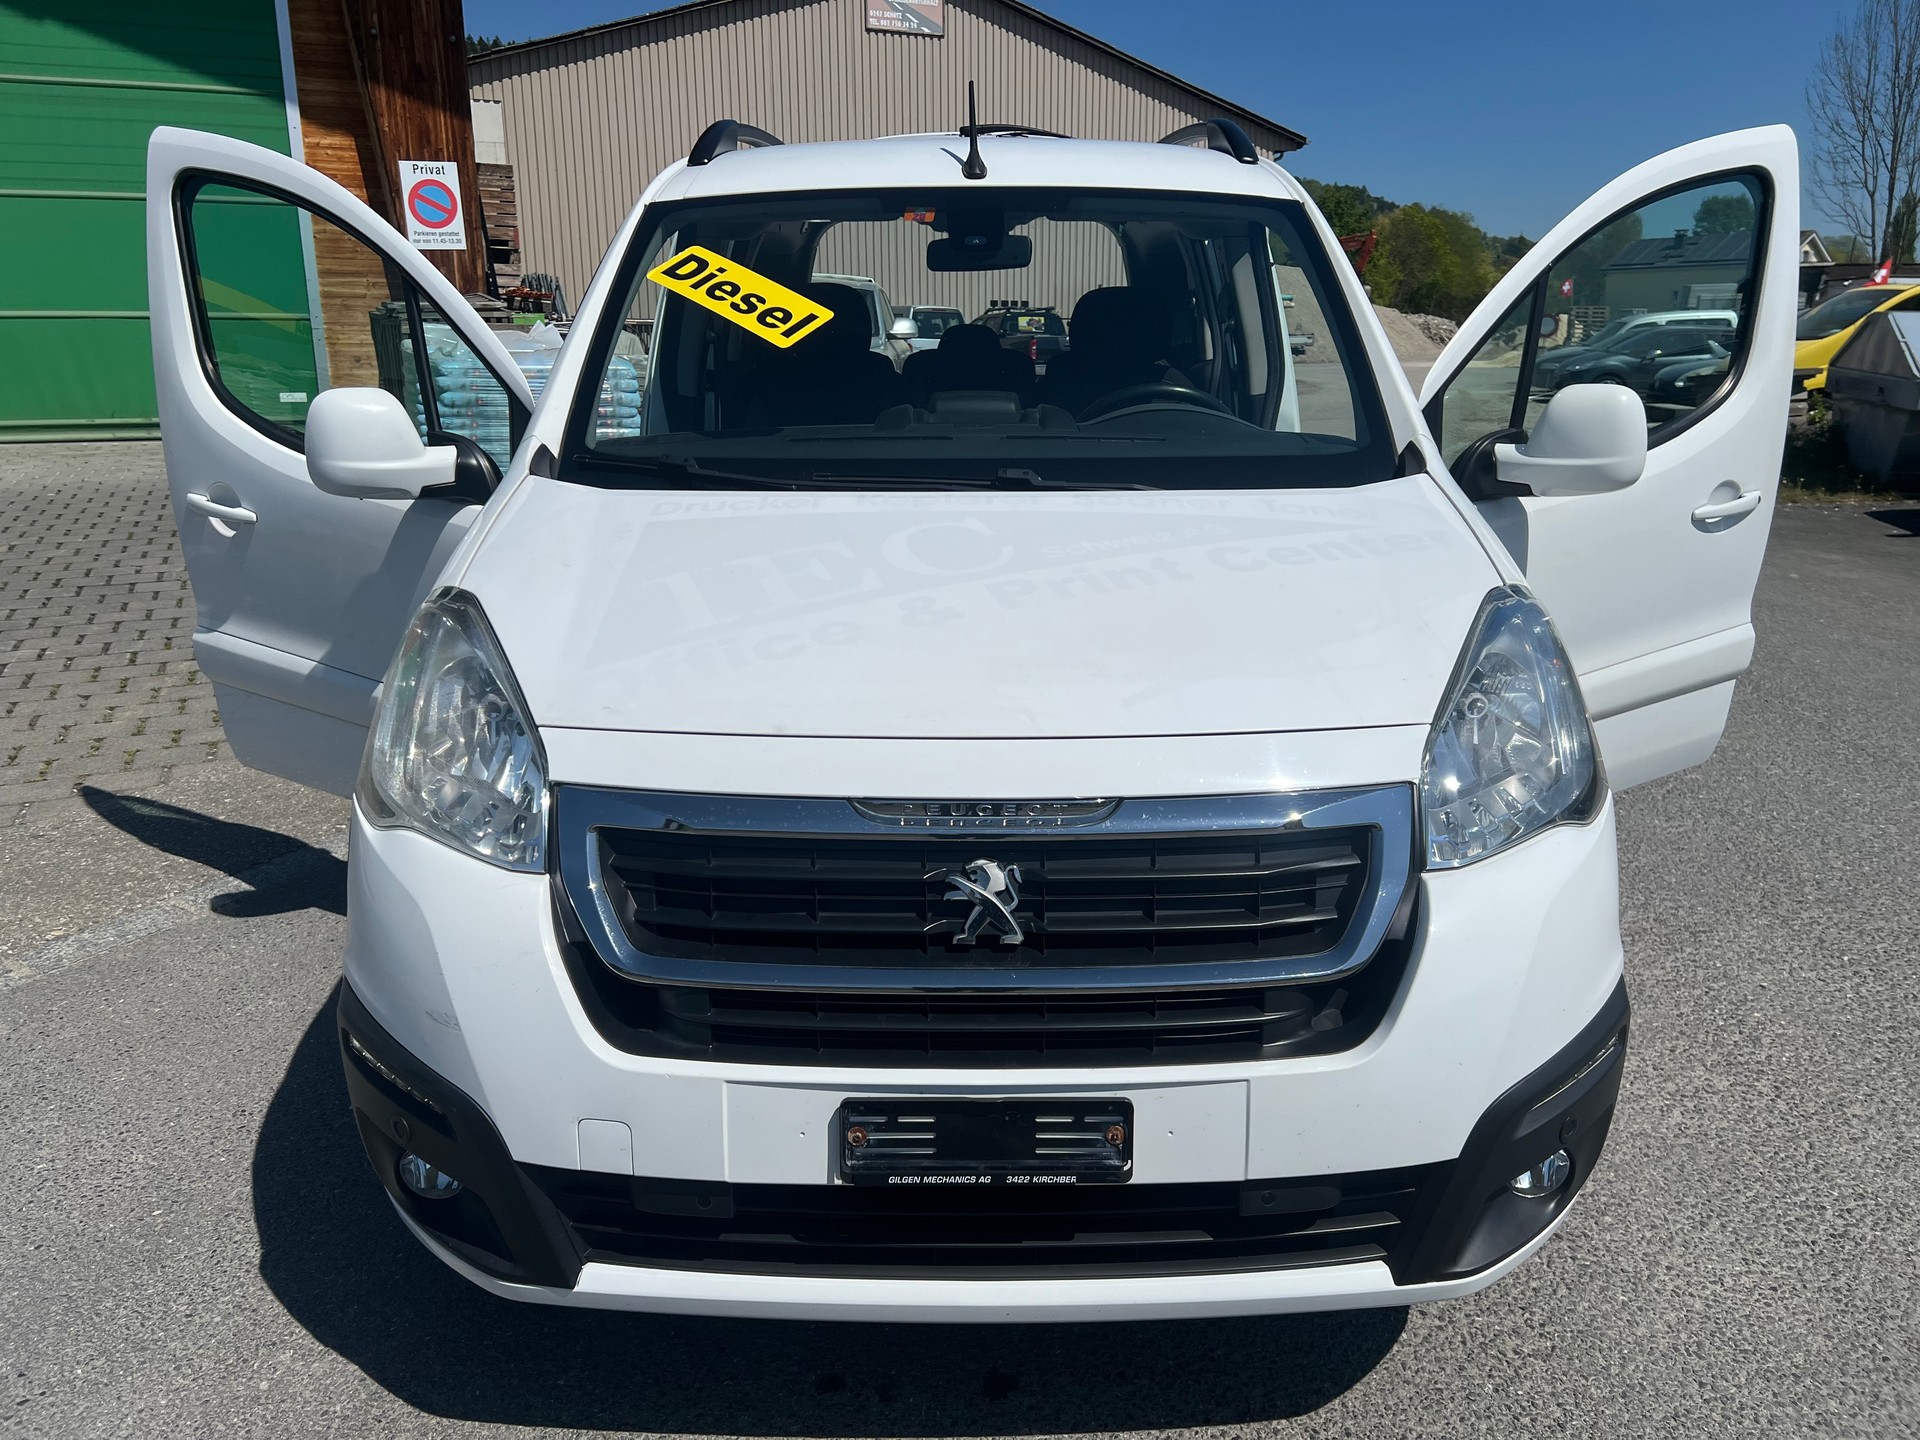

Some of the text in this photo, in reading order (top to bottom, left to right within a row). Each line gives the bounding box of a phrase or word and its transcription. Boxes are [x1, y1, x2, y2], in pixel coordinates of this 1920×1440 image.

[412, 163, 446, 175] Privat
[660, 253, 820, 339] Diesel
[1041, 529, 1179, 560] Schweiz
[899, 595, 965, 627] &
[983, 556, 1195, 610] Print
[1205, 529, 1456, 573] Center
[901, 803, 1069, 816] PEUGEOT
[888, 1175, 921, 1184] GILGEN
[922, 1175, 977, 1184] MECHANICS
[978, 1175, 992, 1184] AG
[1005, 1175, 1031, 1184] 3422
